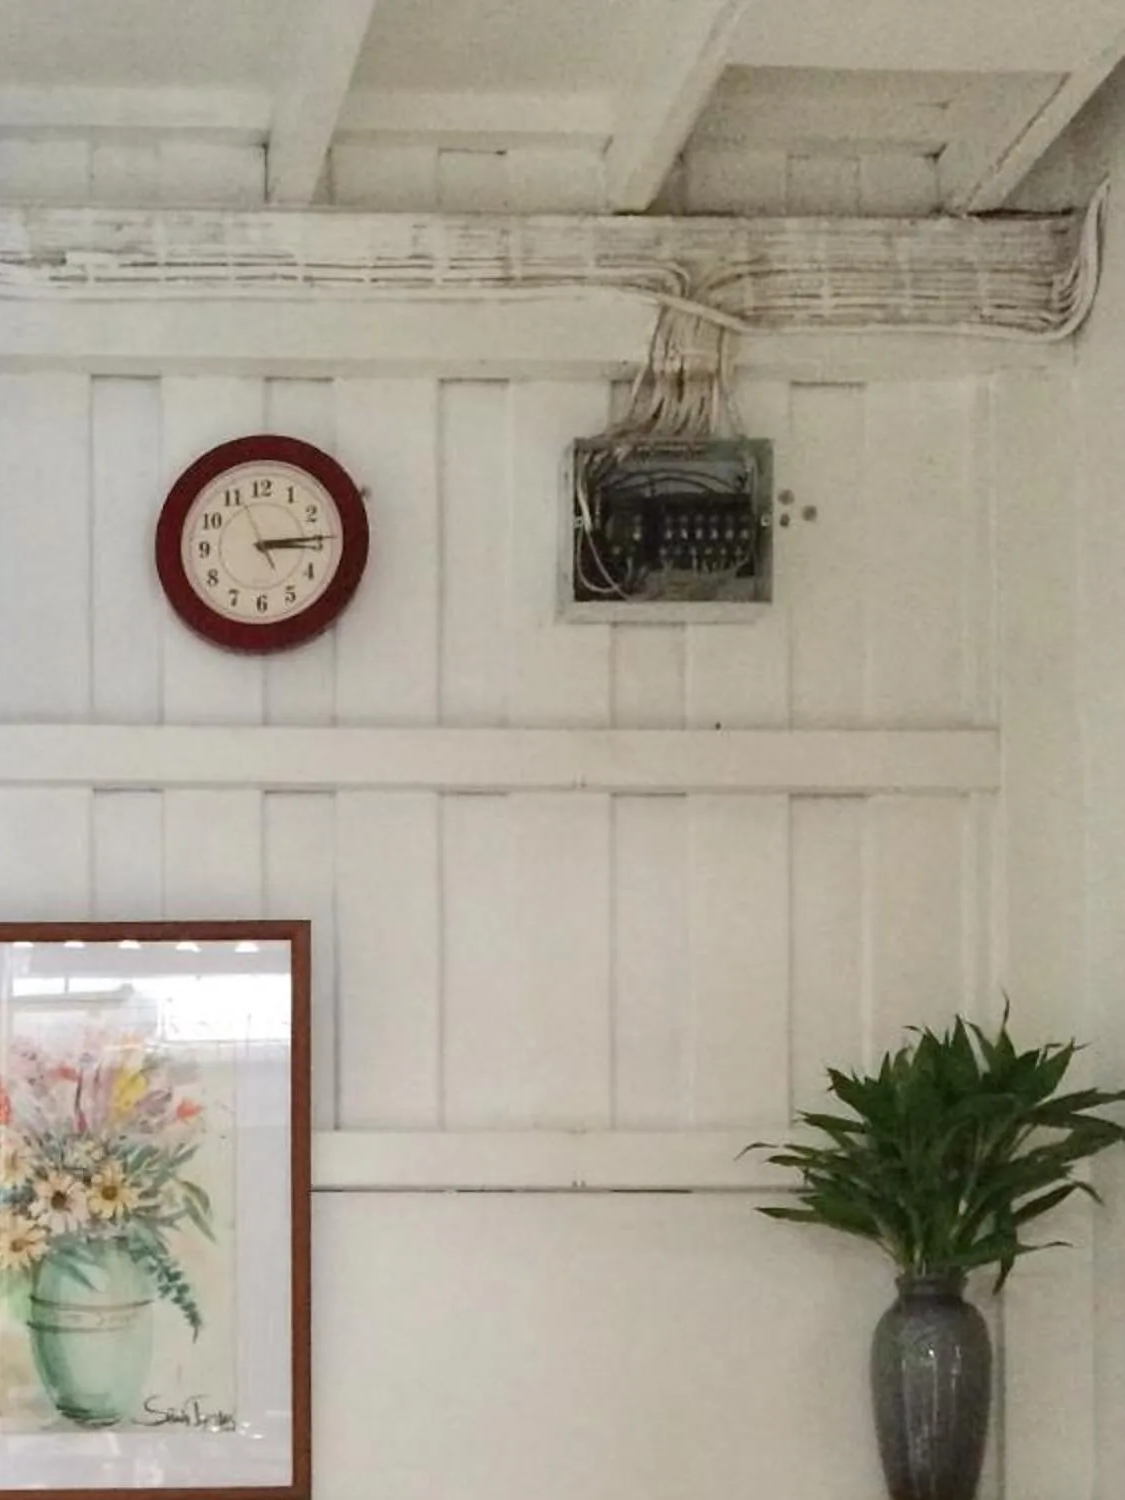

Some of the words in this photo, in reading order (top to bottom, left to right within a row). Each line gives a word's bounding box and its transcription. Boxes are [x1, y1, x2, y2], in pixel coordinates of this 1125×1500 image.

[252, 480, 272, 498] 12
[287, 487, 295, 504] 1
[225, 490, 241, 507] 11
[202, 513, 222, 530] 10
[305, 505, 317, 523] 2
[199, 542, 210, 559] 9
[313, 535, 324, 551] 3
[207, 570, 218, 587] 8
[303, 562, 313, 580] 4
[229, 590, 239, 607] 7
[285, 586, 296, 604] 5
[256, 596, 268, 613] 6
